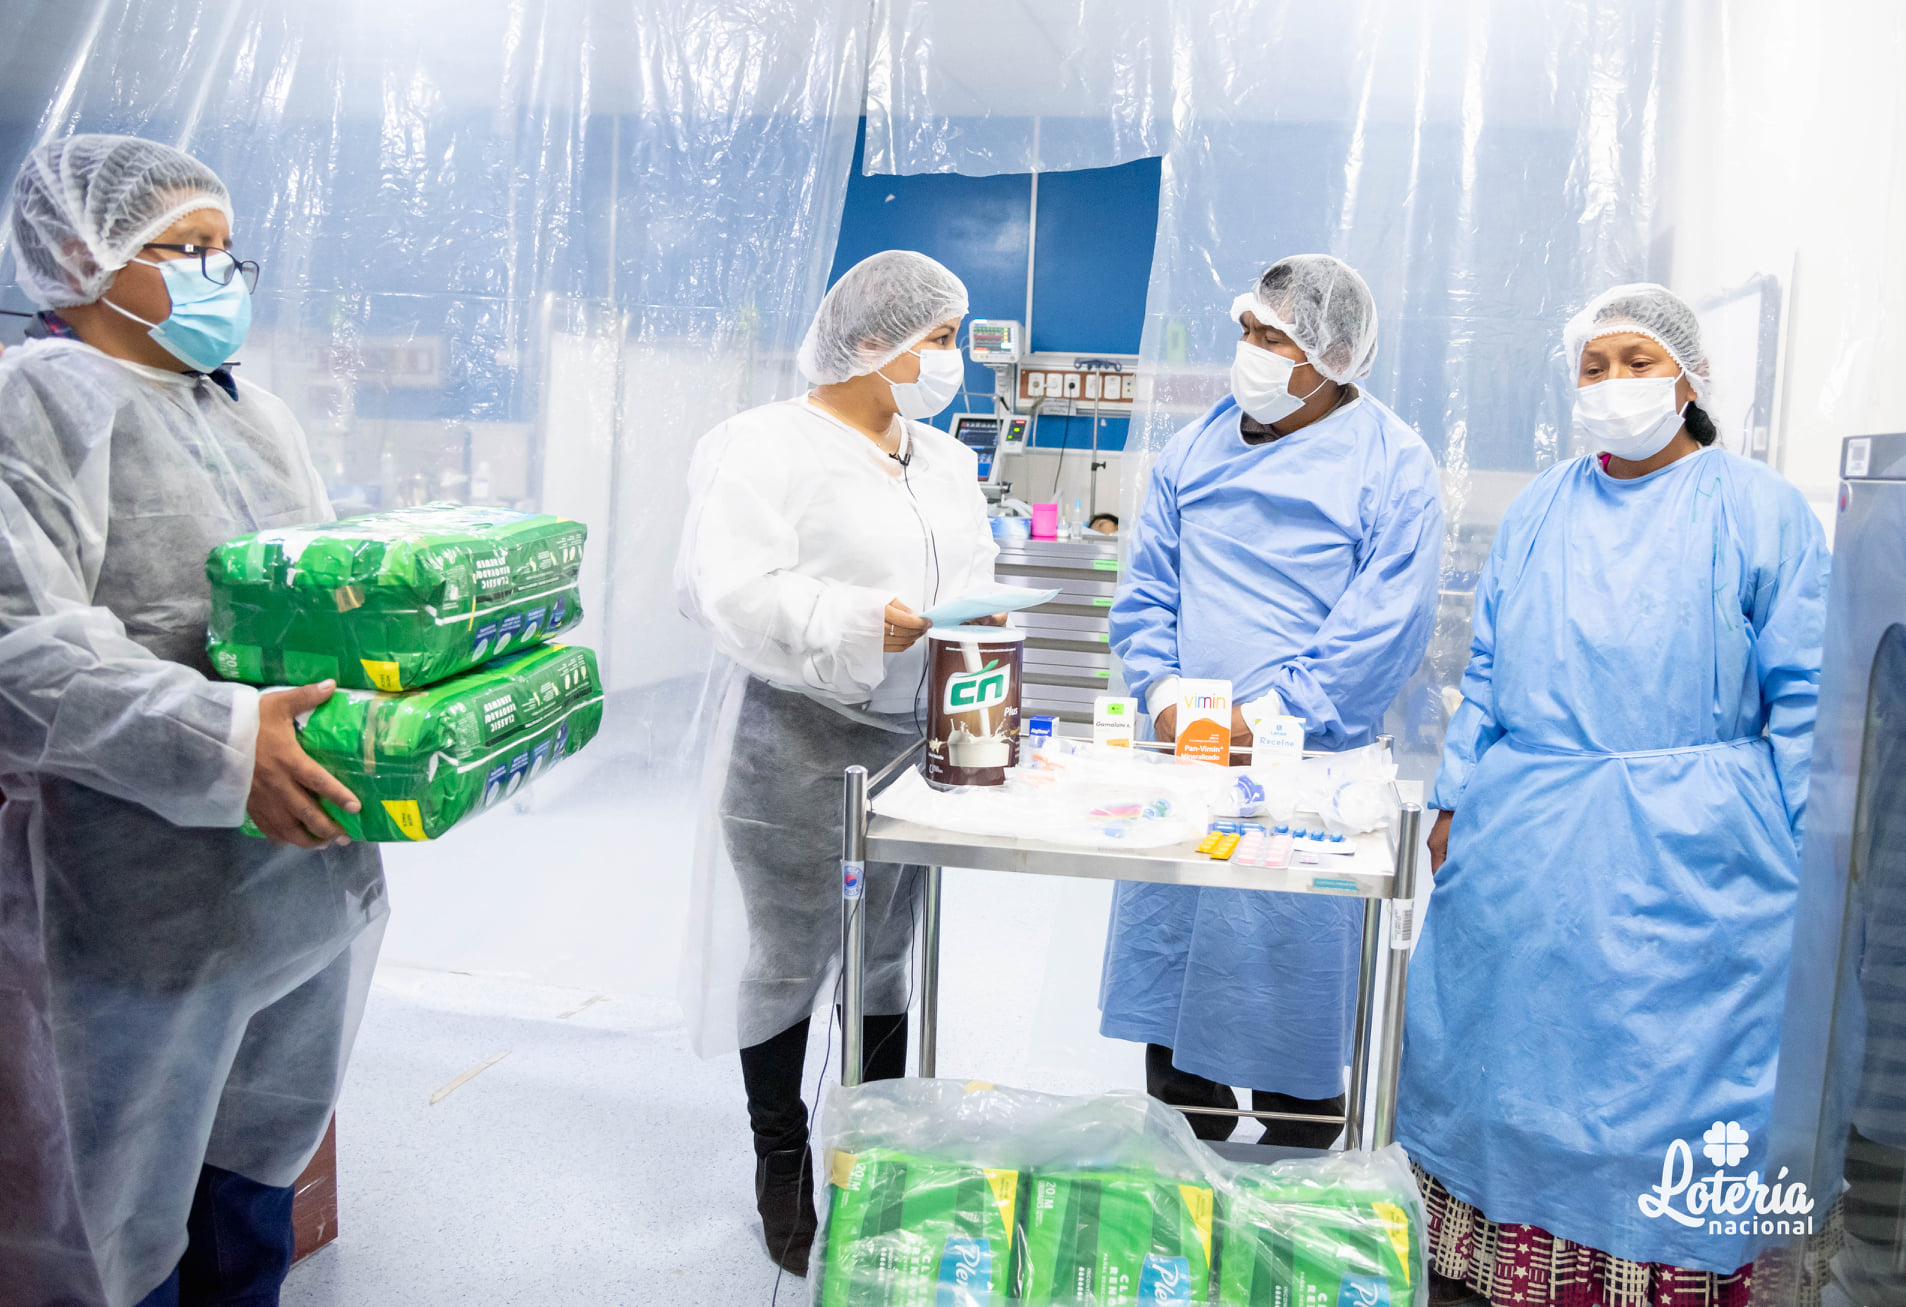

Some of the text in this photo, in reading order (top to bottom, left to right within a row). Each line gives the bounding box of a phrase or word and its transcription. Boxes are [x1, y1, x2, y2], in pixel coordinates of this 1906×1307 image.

[226, 653, 238, 667] 20
[950, 674, 1004, 706] cn
[1184, 692, 1226, 709] vimin
[1004, 706, 1019, 717] Plus
[490, 713, 515, 733] CLASSIC
[852, 1163, 866, 1191] 20 M
[1044, 1182, 1057, 1209] 20 M
